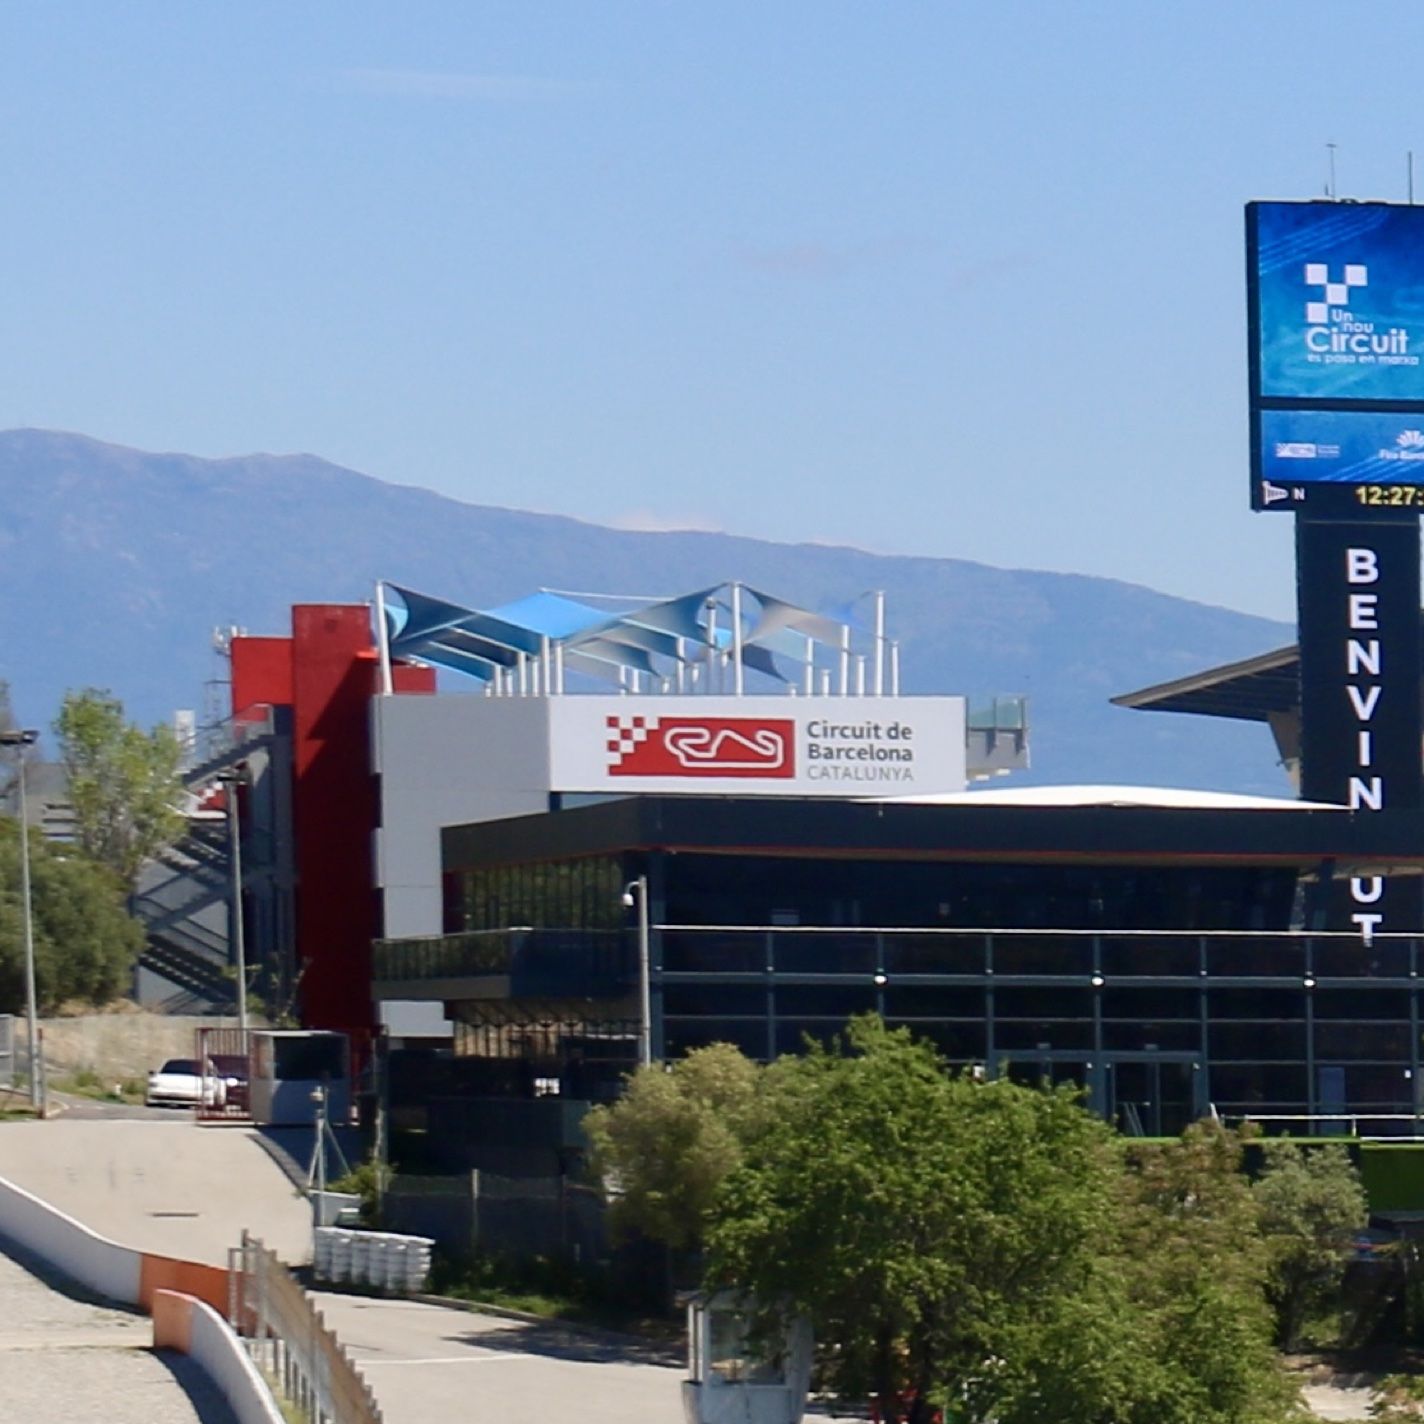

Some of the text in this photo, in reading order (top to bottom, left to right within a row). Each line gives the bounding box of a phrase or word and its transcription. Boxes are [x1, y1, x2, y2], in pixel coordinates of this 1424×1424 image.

[1331, 309, 1353, 322] Un
[1343, 322, 1374, 333] nou
[1306, 326, 1409, 354] Circuit
[1292, 487, 1305, 500] N
[806, 719, 913, 740] Circuit de
[807, 742, 913, 761] Barcelona
[1347, 548, 1382, 947] BENVINUT
[806, 764, 914, 781] CATALUNYA
